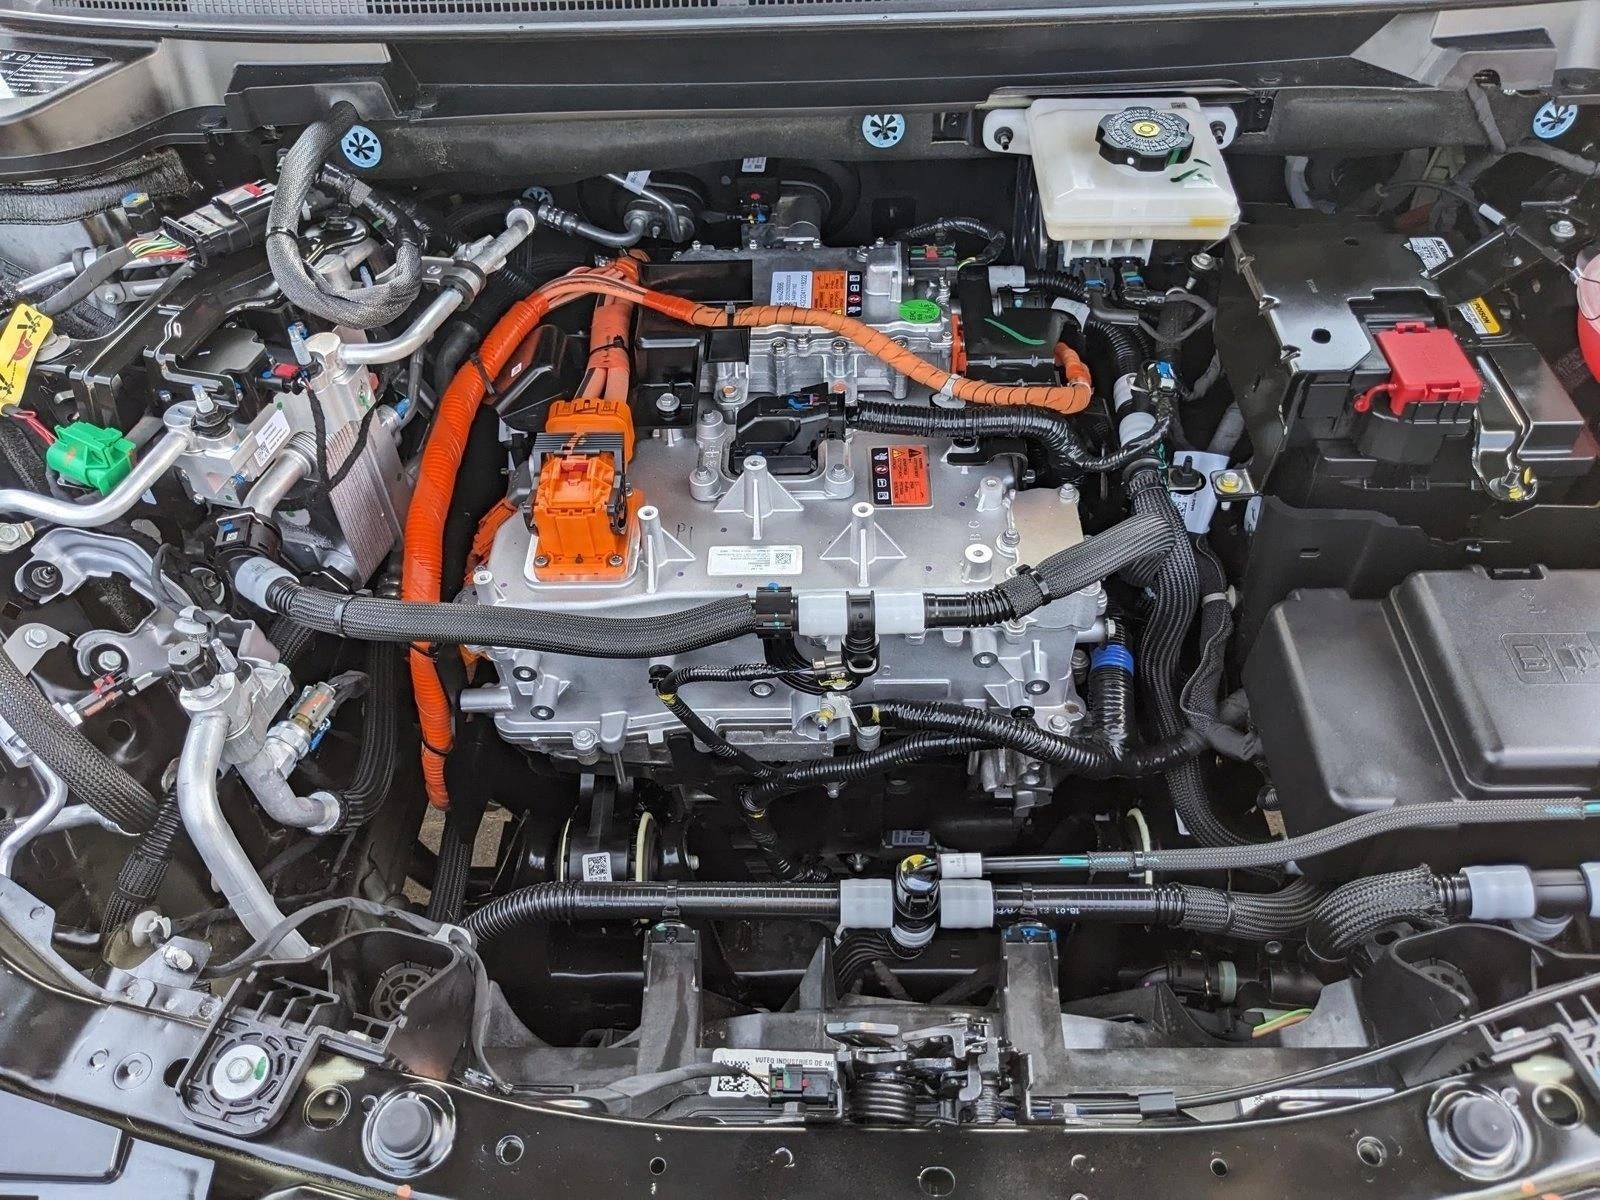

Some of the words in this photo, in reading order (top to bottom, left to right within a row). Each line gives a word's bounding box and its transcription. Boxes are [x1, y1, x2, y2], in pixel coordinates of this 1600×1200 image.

[1473, 302, 1491, 324] POISON
[776, 1057, 813, 1066] INDUSTRIES
[814, 1059, 822, 1067] DE
